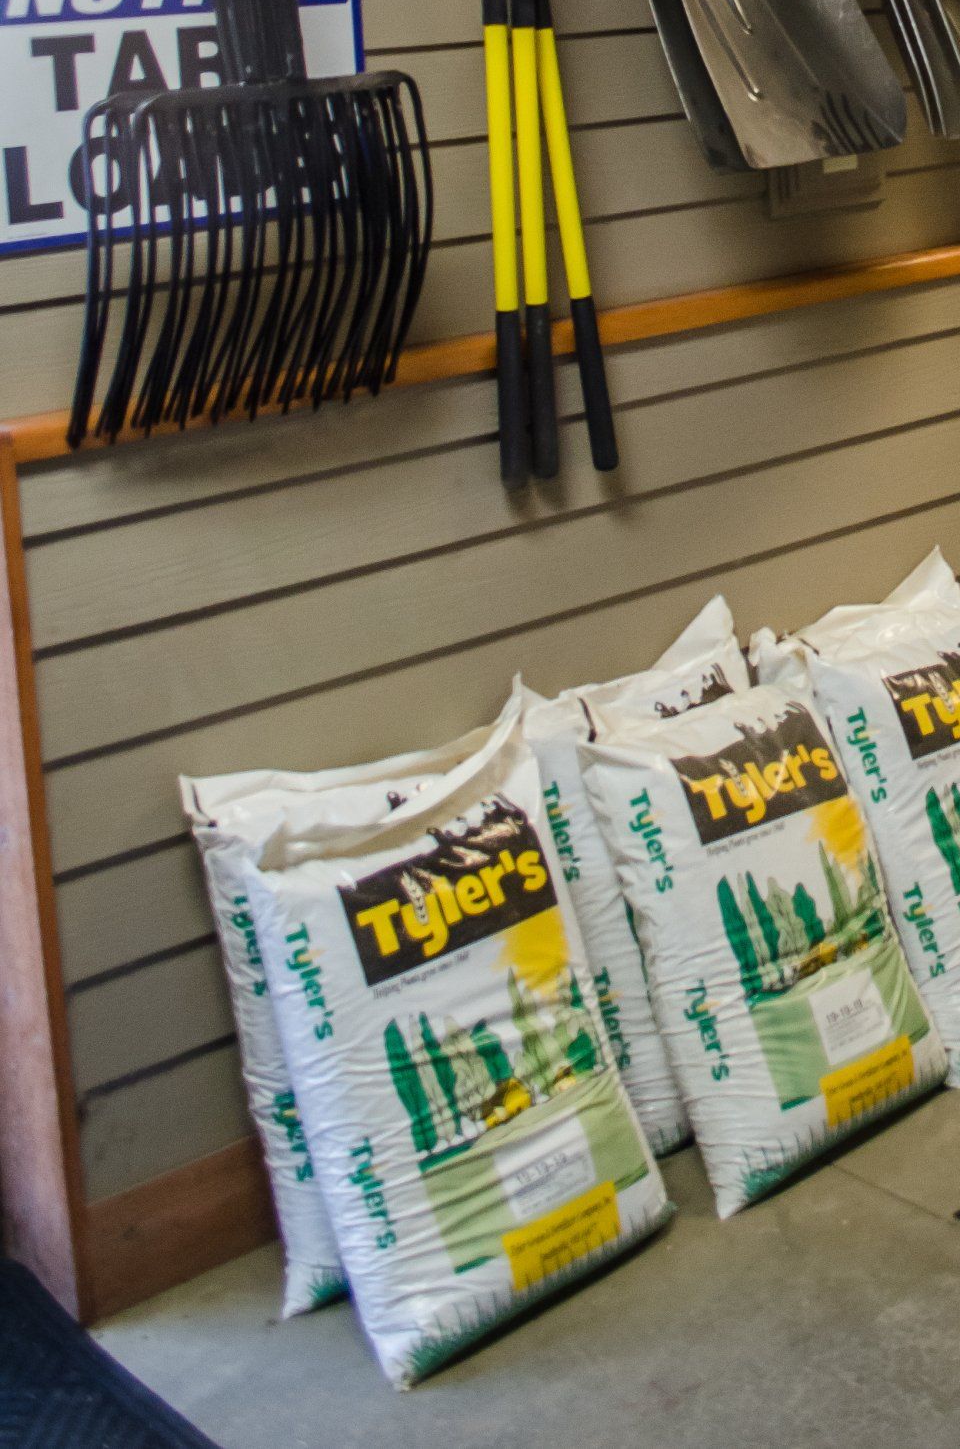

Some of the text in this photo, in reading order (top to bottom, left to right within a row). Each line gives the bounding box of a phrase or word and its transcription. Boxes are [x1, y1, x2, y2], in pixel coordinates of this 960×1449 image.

[688, 743, 839, 824] Tyler's
[847, 706, 888, 804] Tyler's
[629, 787, 674, 893] Tyler's
[356, 849, 548, 958] Tyler's
[903, 881, 946, 978] Tyler's
[285, 922, 335, 1040] Tyler's
[684, 979, 731, 1082] Tyler's
[349, 1136, 398, 1250] Tyler's
